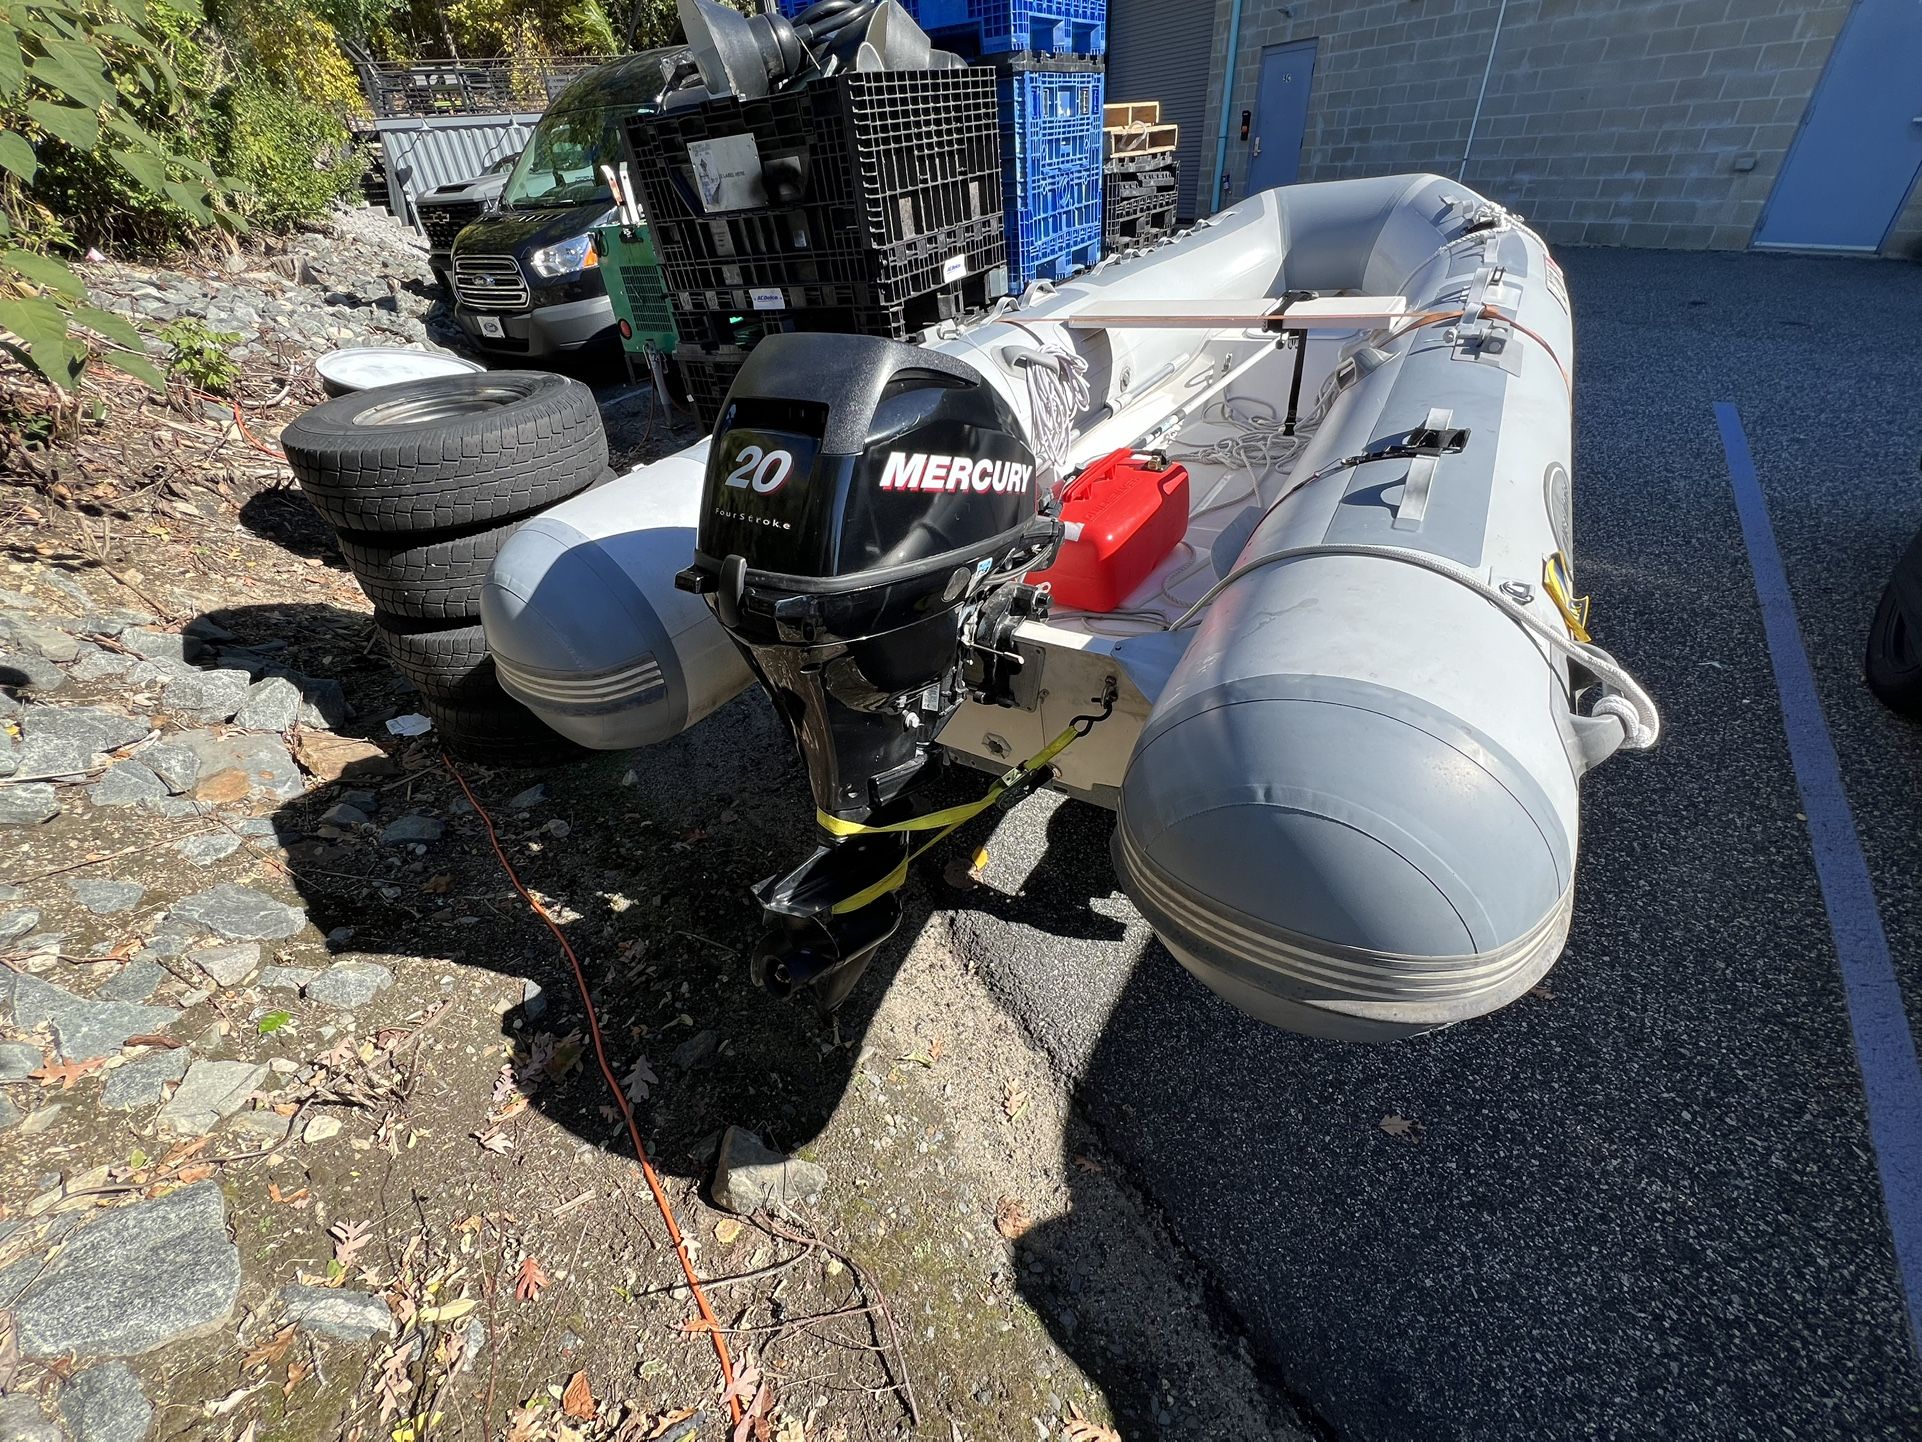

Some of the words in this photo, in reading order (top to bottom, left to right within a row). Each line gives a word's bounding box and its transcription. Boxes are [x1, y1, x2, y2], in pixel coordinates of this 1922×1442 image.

[724, 445, 795, 495] 20
[879, 451, 1033, 495] MERCURY
[715, 507, 792, 530] FourStroke
